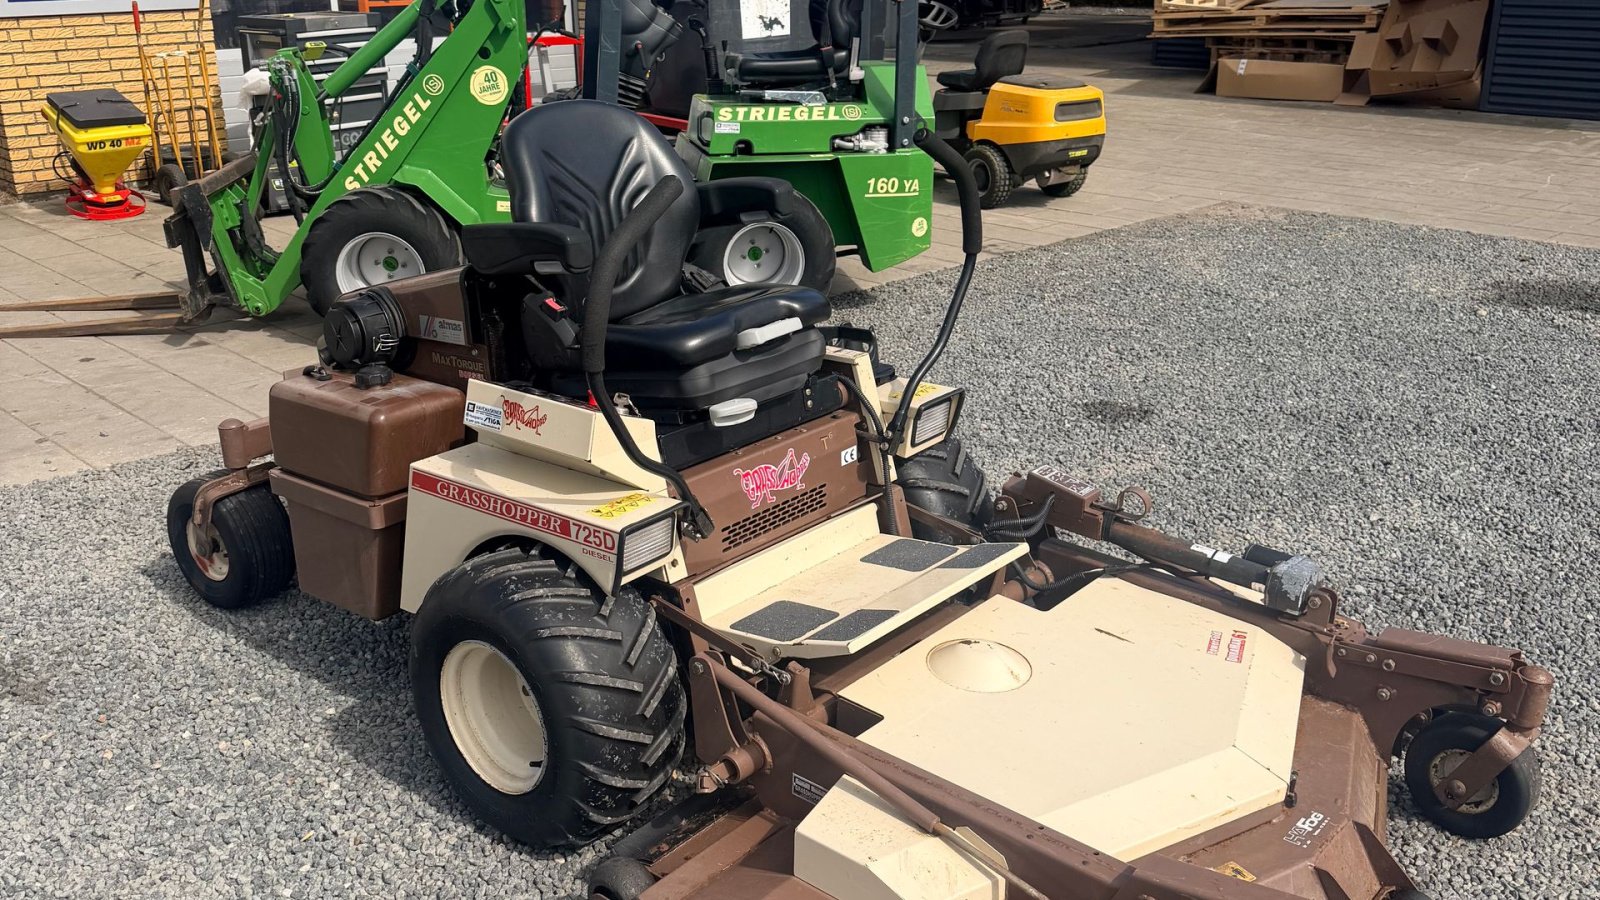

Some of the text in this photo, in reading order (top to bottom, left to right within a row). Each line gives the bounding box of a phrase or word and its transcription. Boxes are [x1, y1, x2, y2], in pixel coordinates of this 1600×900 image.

[484, 71, 498, 83] 40
[479, 82, 501, 94] JAHRE
[718, 106, 840, 121] STRIEGEL
[87, 141, 106, 151] WD
[109, 139, 122, 148] 40
[344, 92, 432, 191] STRIEGEL
[867, 177, 920, 194] 160 YA
[436, 481, 616, 552] GRASSHOPPER 725D
[582, 547, 614, 563] DIESEL
